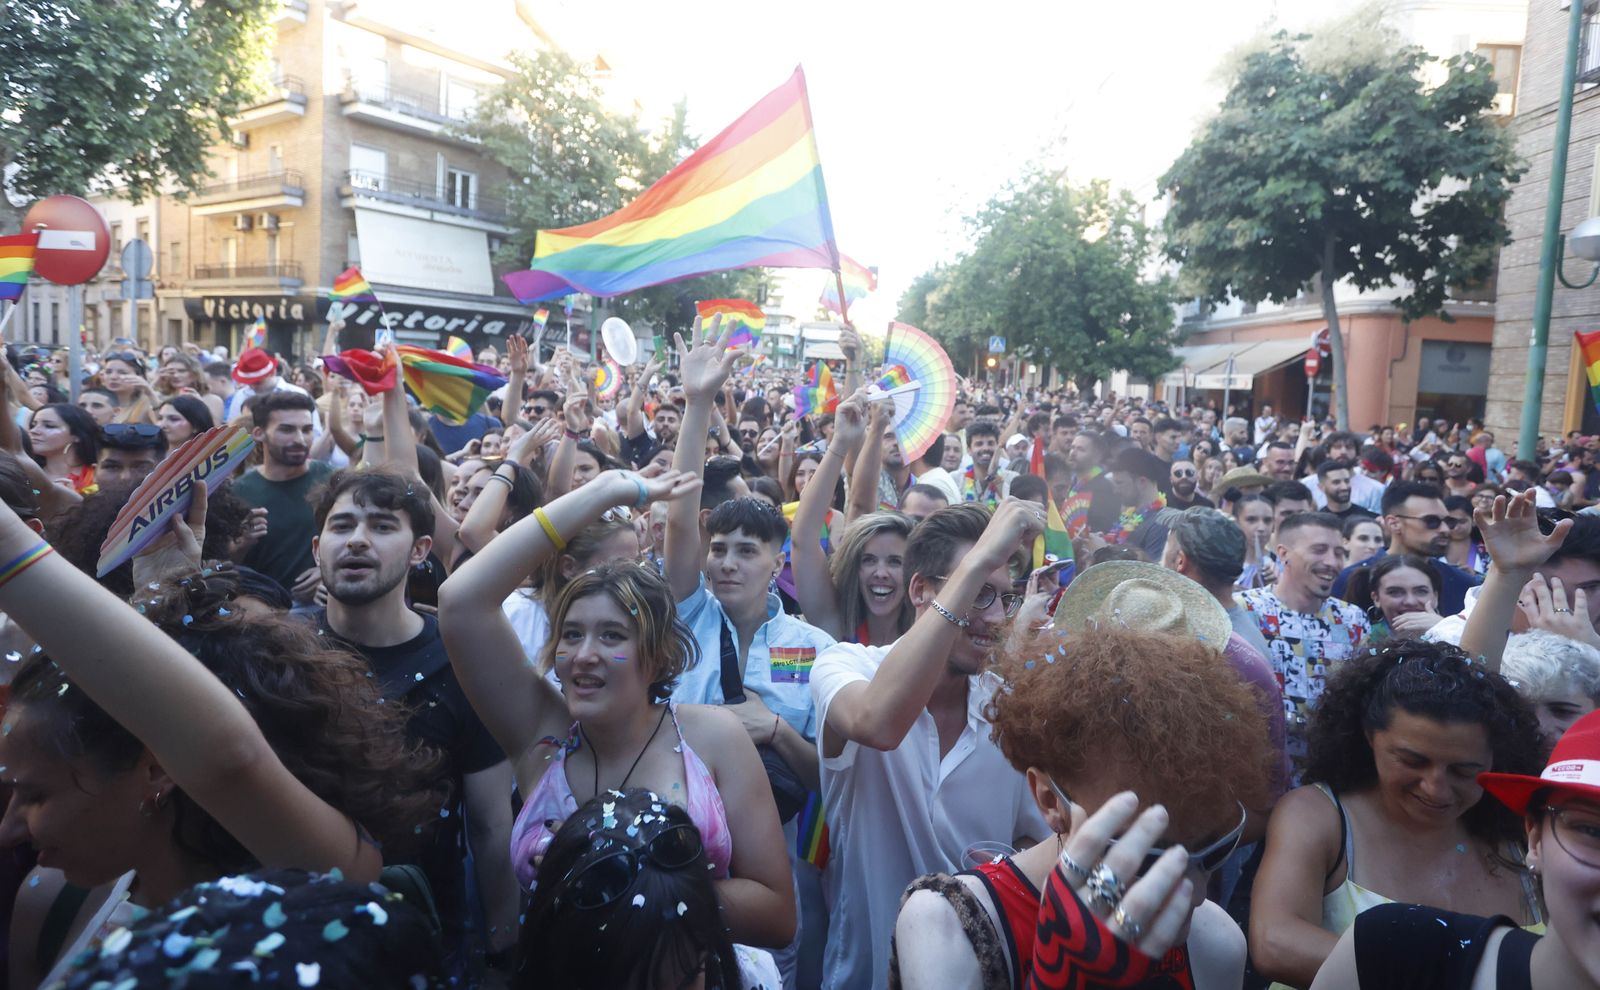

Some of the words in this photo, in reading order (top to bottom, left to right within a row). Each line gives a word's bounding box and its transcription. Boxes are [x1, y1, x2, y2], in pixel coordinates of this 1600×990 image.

[204, 298, 304, 320] Victoria
[326, 301, 506, 335] Victoria
[127, 445, 230, 543] AIRBUS
